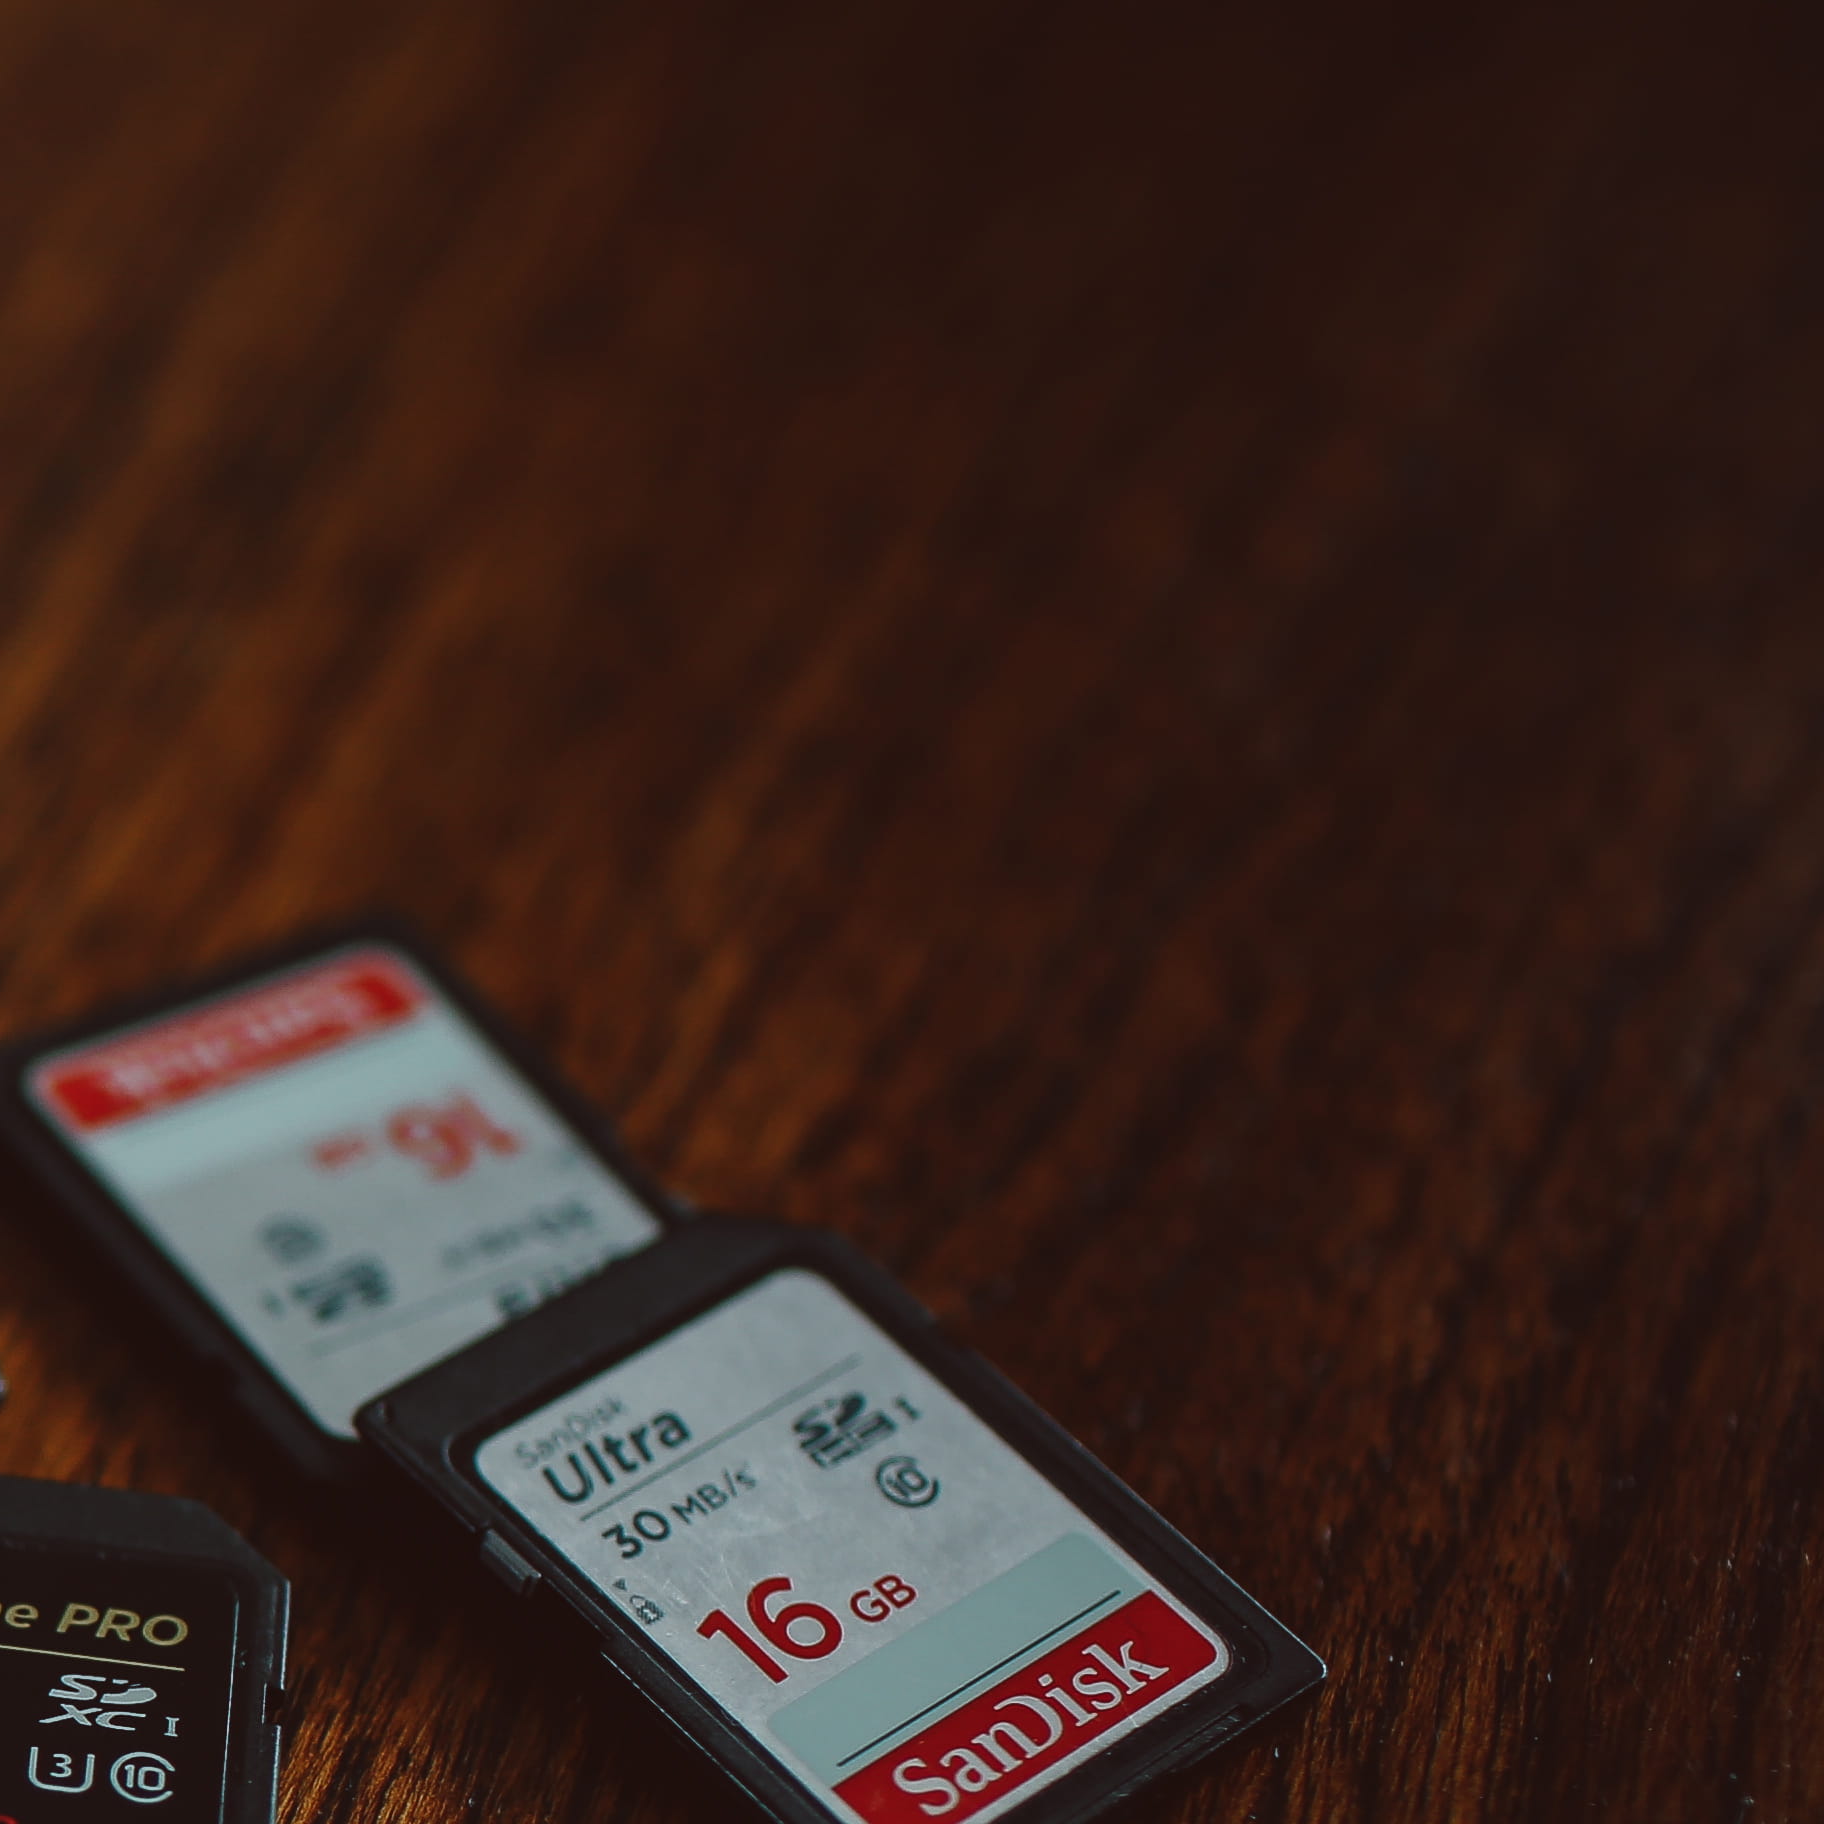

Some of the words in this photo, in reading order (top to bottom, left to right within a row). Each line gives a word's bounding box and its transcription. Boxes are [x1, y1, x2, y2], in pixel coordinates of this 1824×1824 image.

[541, 1409, 693, 1506] Ultra
[602, 1509, 672, 1561] 30
[56, 1601, 190, 1648] PRO
[696, 1575, 846, 1684] 16
[848, 1572, 918, 1627] GB
[891, 1632, 1170, 1817] SanDisk
